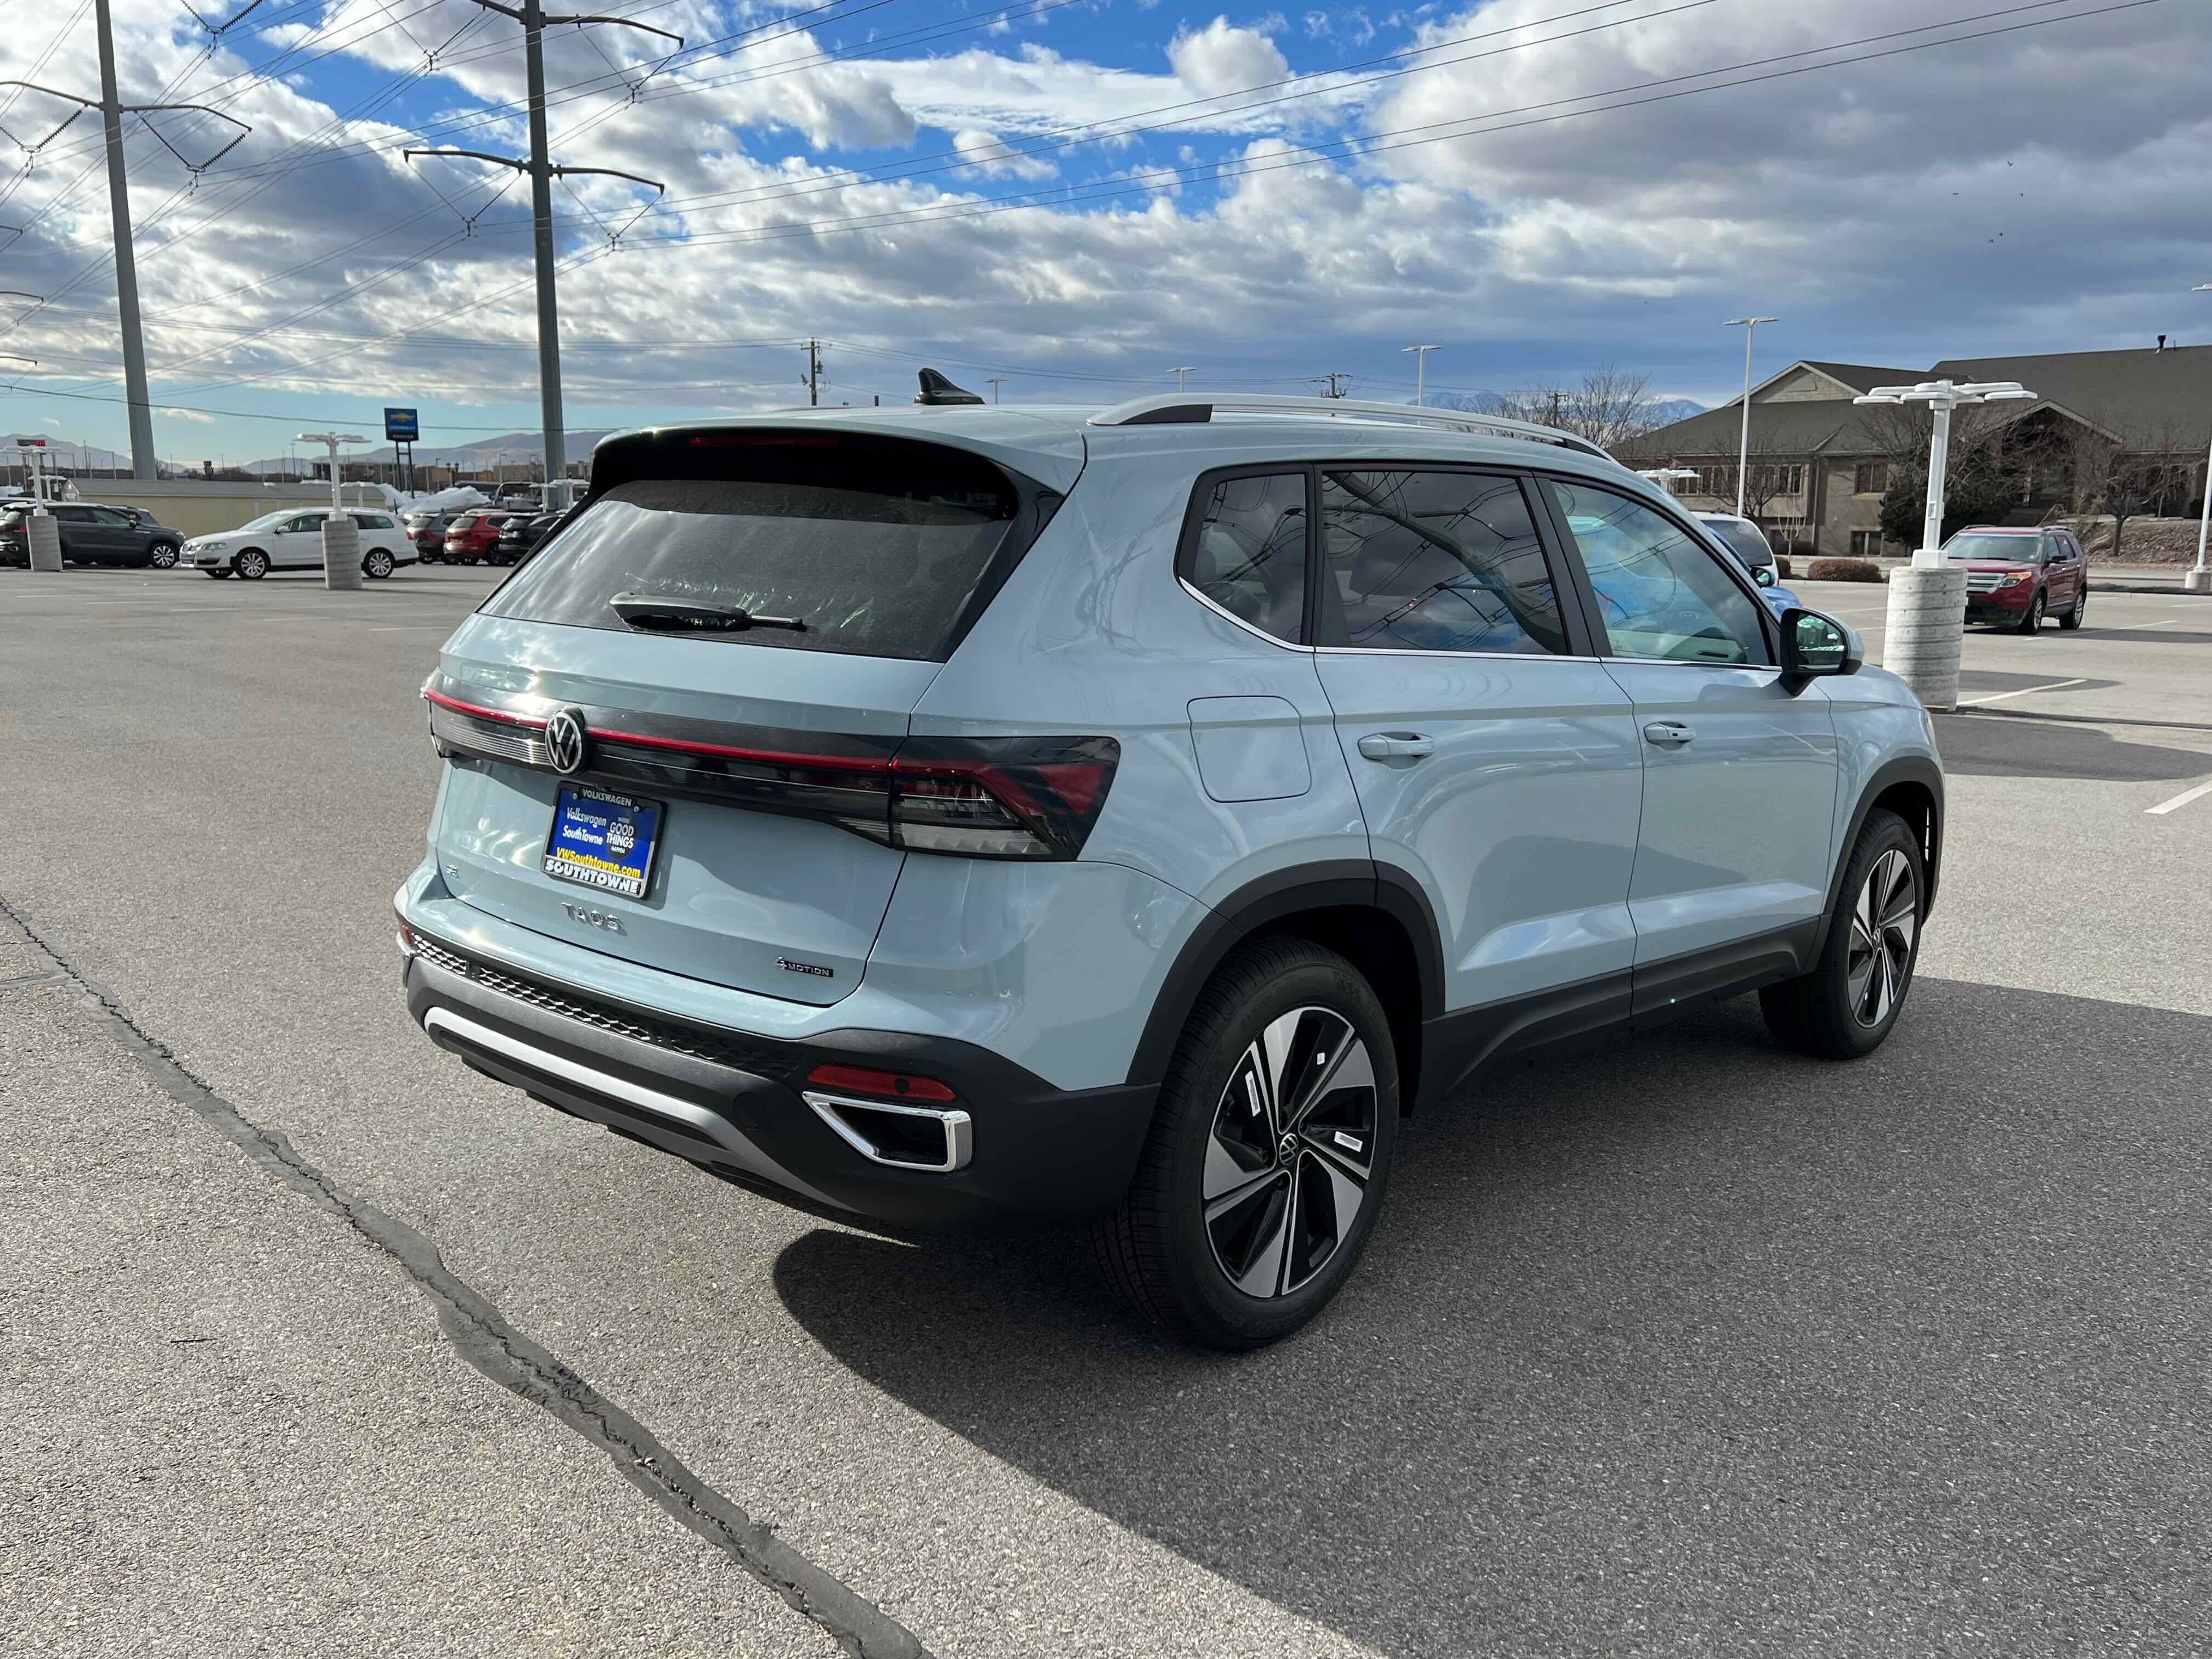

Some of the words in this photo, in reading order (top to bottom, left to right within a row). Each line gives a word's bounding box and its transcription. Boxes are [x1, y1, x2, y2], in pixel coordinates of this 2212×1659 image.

[582, 788, 631, 806] VOLKSWAGEN
[567, 807, 606, 828] Volkswagen
[562, 825, 603, 845] SouthTowne
[610, 822, 634, 836] GOOD
[606, 832, 634, 849] THINGS
[556, 847, 641, 877] VWSouthtowne.com
[545, 860, 639, 893] SOUTHTOWNE
[561, 902, 619, 931] TAOS
[773, 956, 830, 976] 4MOTION
